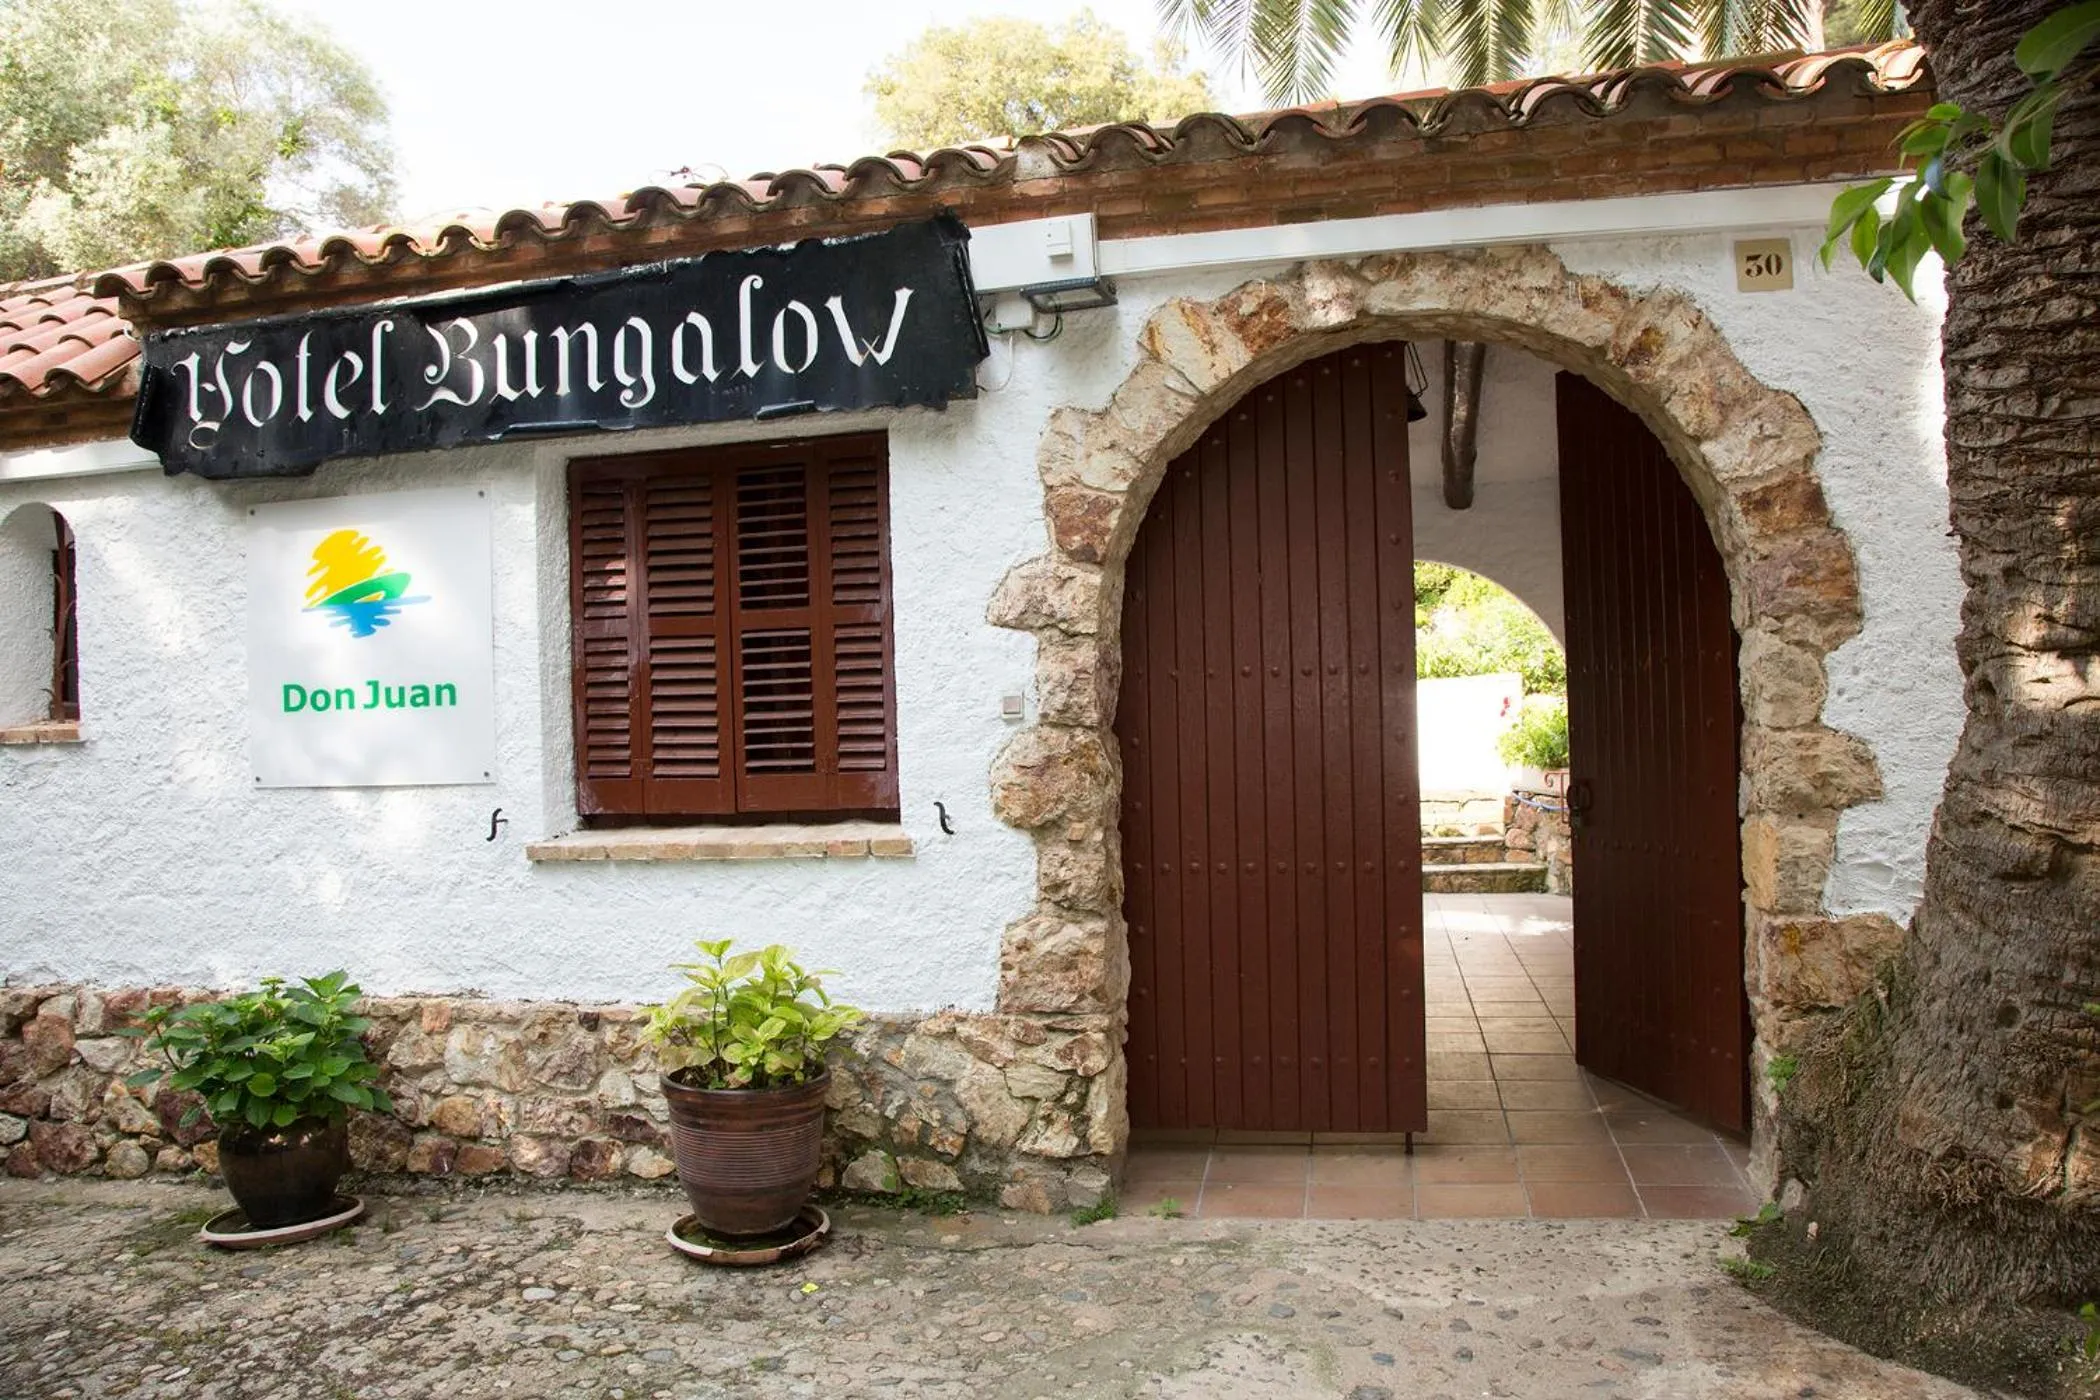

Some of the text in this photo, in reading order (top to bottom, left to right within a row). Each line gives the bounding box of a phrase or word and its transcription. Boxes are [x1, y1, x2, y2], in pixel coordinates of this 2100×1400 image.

[170, 273, 915, 450] Hotel Bungalow
[283, 680, 457, 713] Don Juan
